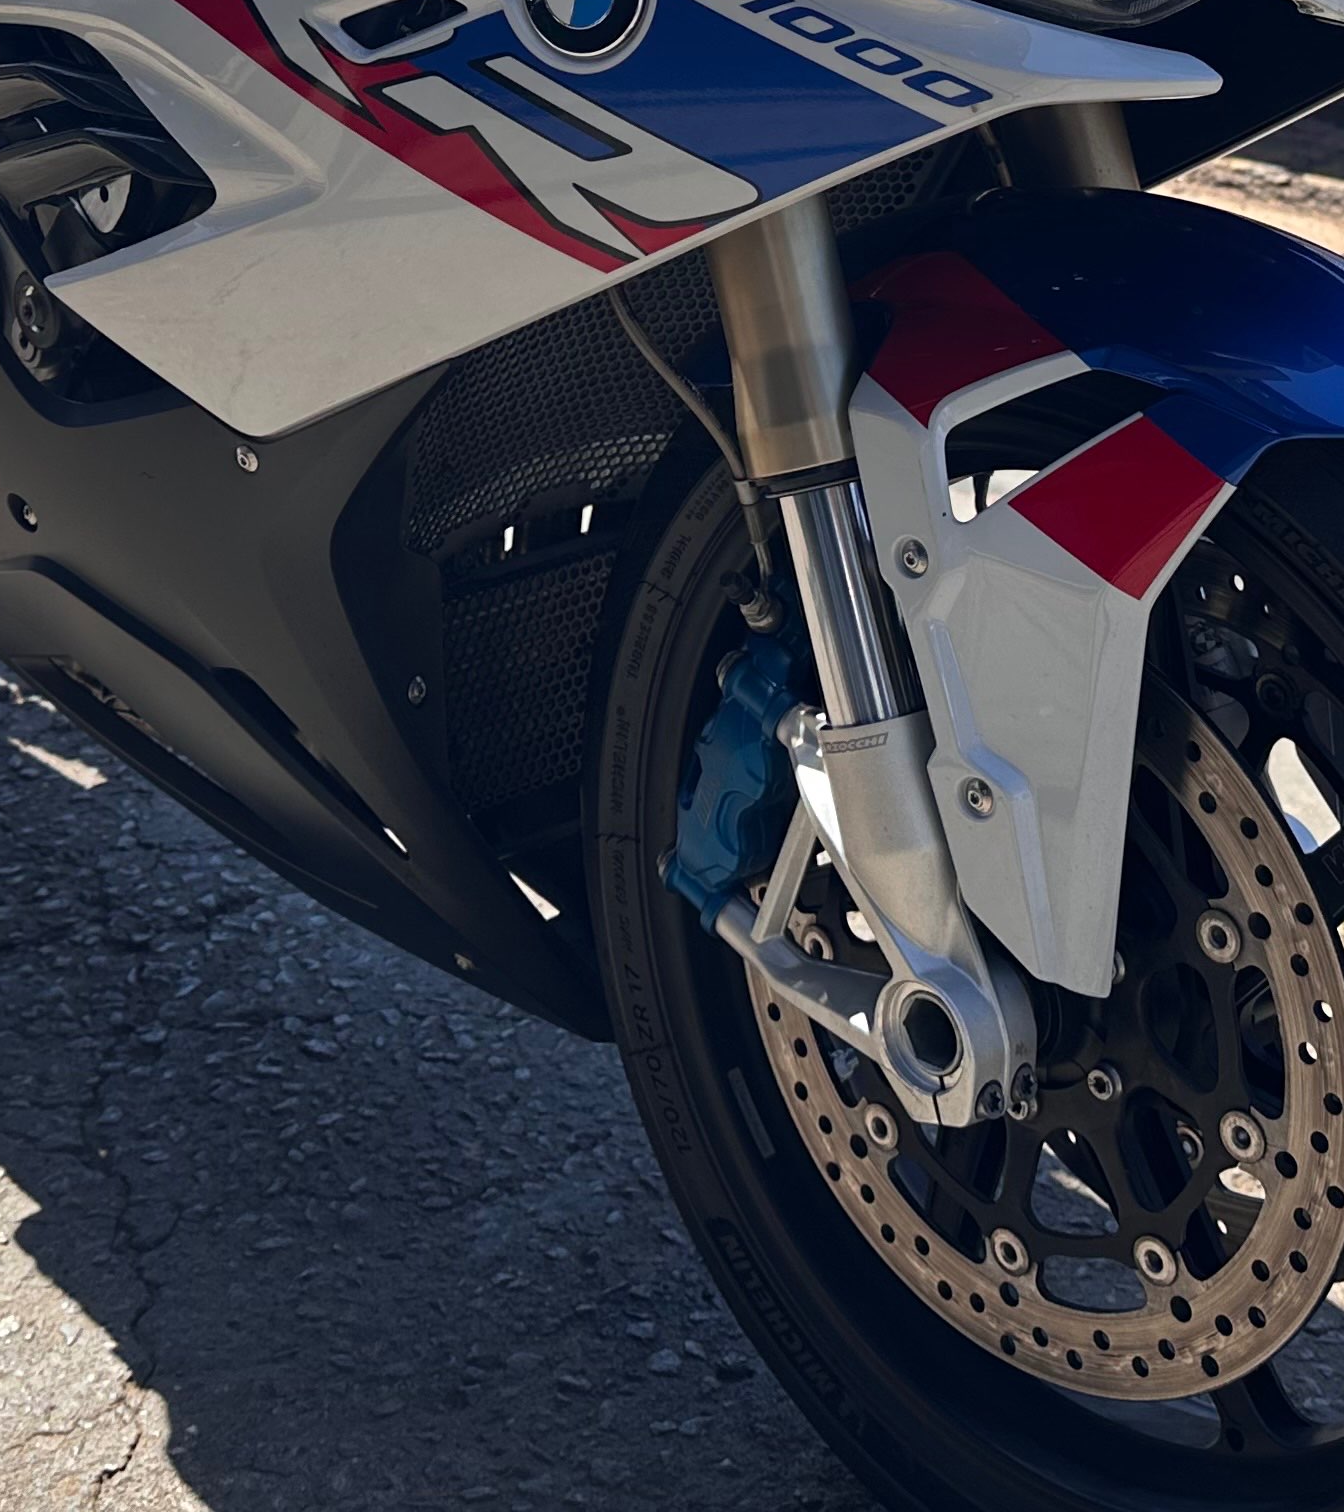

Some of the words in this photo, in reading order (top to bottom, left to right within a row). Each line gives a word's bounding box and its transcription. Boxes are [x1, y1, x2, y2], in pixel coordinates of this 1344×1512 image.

[624, 962, 641, 995] 17
[632, 1003, 654, 1044] ZR
[645, 1053, 692, 1154] 120/70
